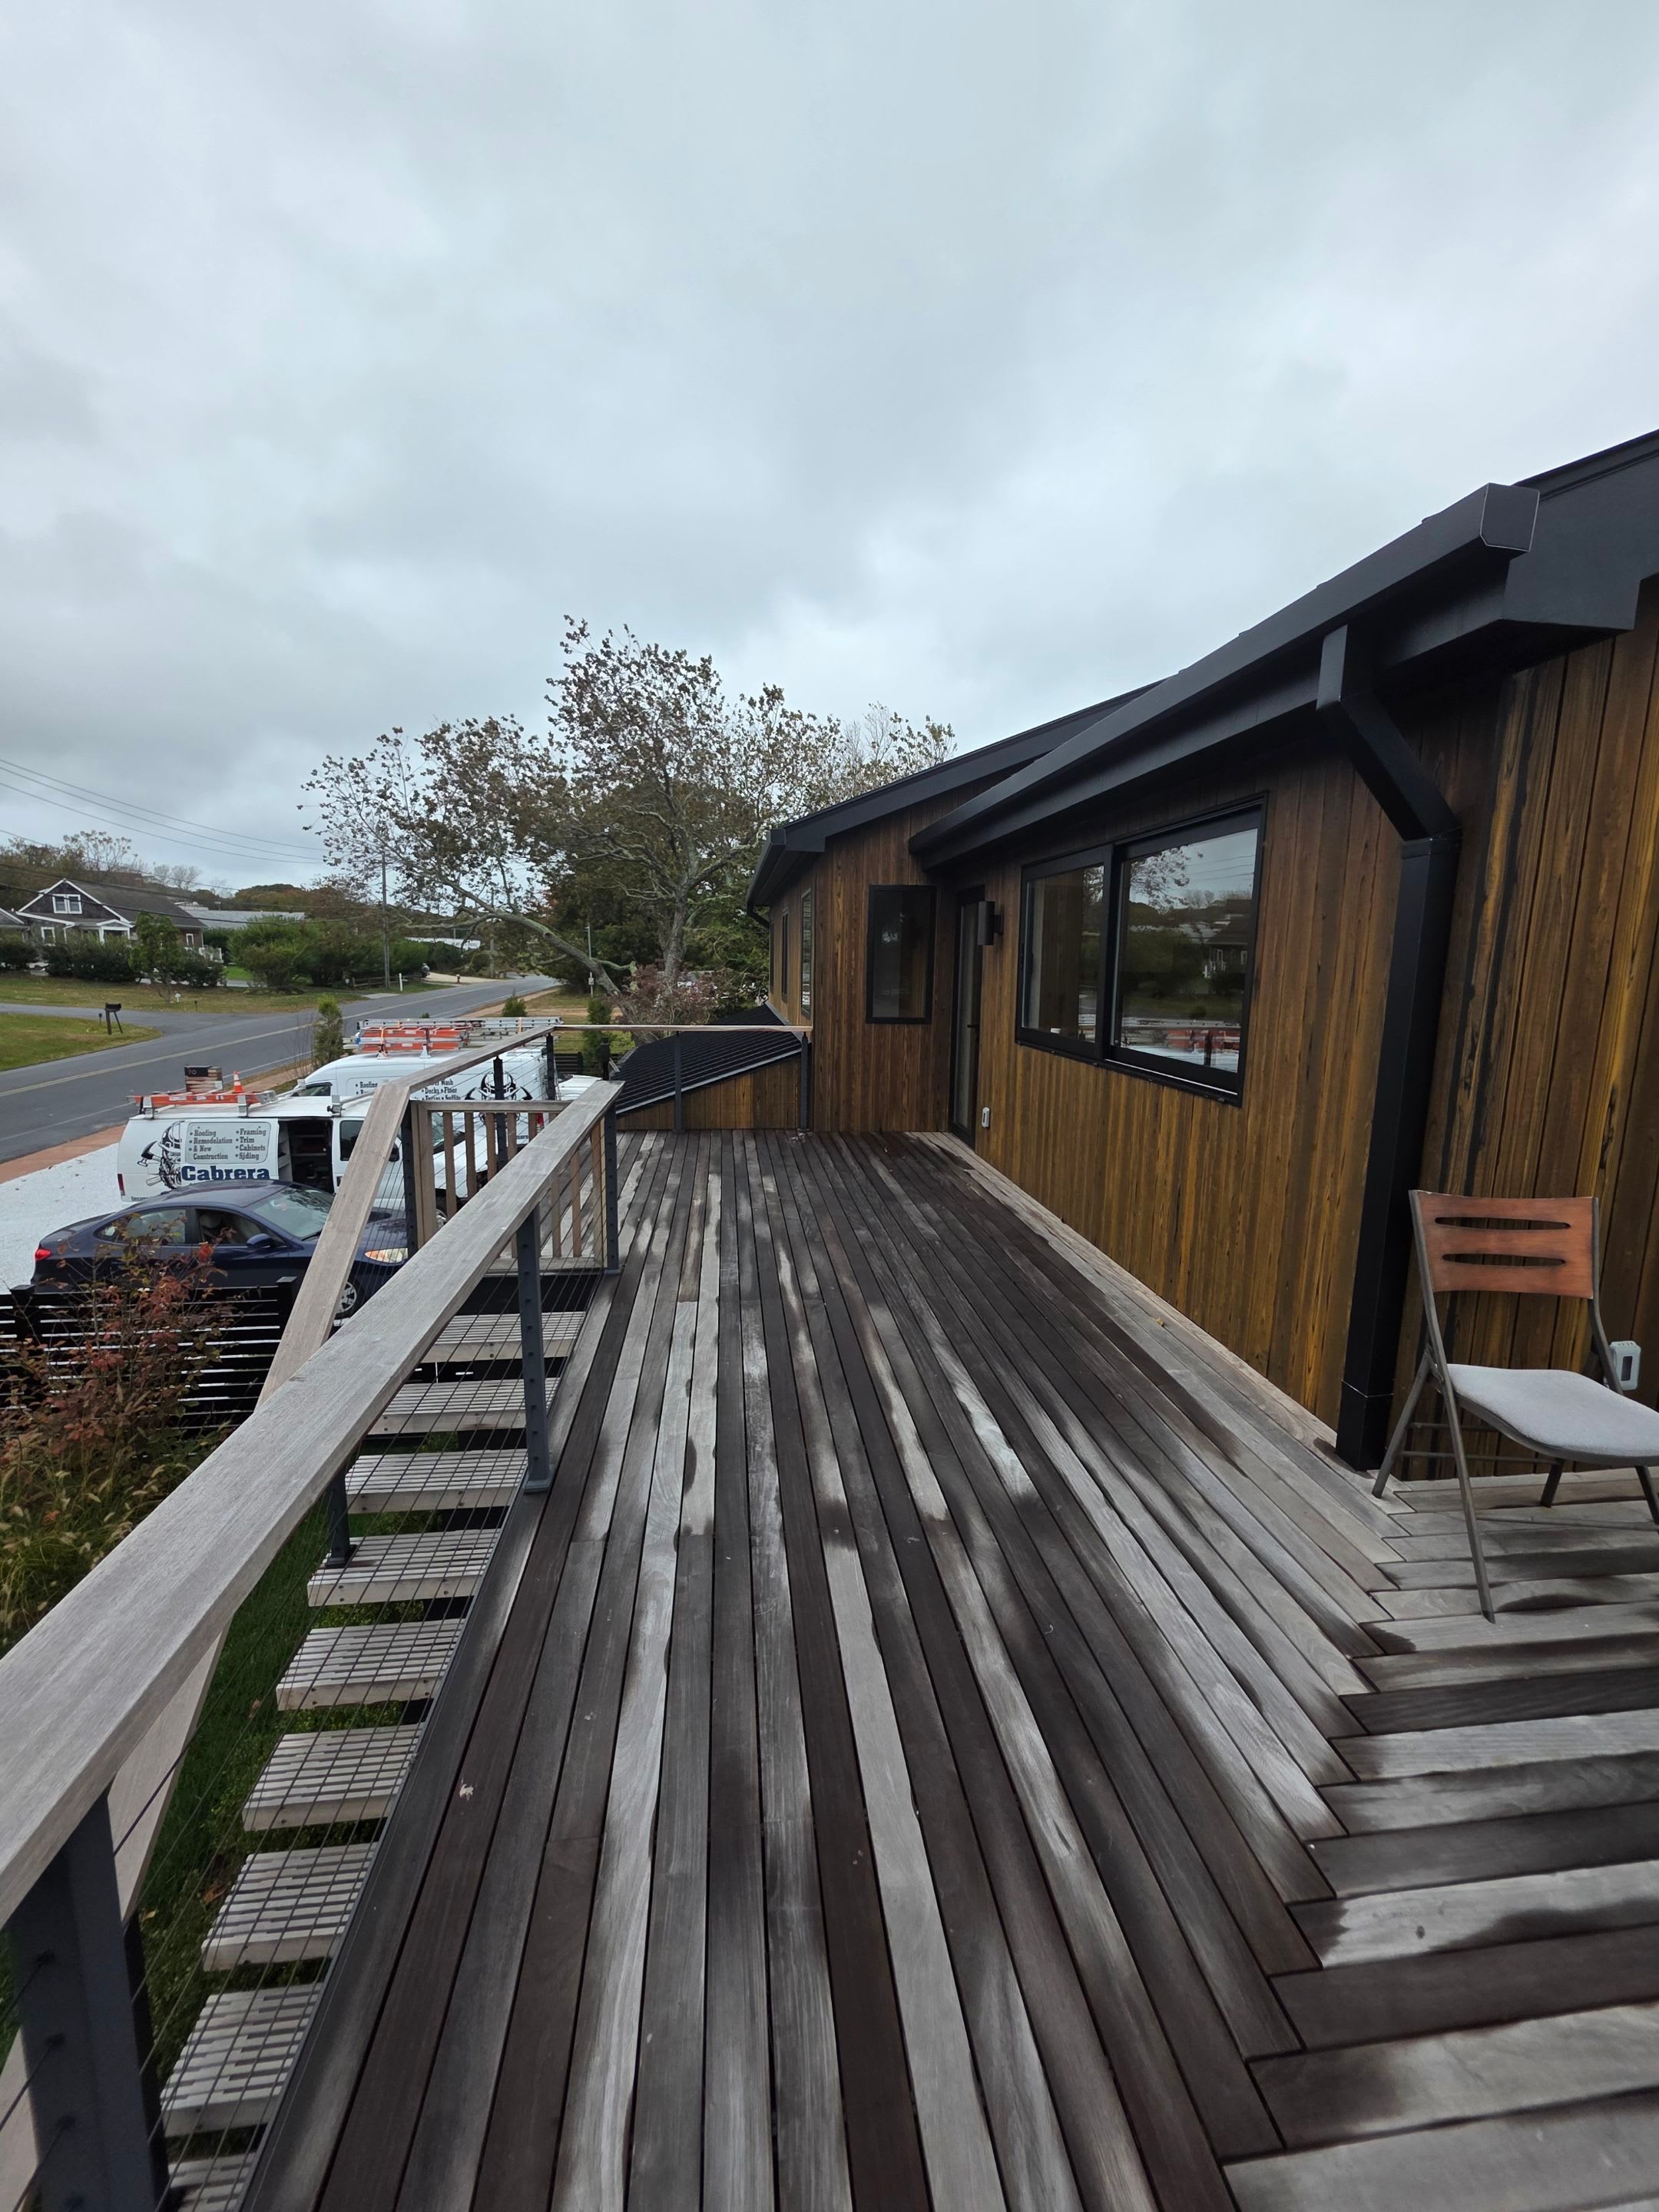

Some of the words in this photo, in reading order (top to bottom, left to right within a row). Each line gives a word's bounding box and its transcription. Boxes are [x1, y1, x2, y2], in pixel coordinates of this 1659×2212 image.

[194, 1129, 217, 1137] Roofing
[240, 1128, 267, 1137] Framing
[181, 1165, 270, 1181] Cabrera
